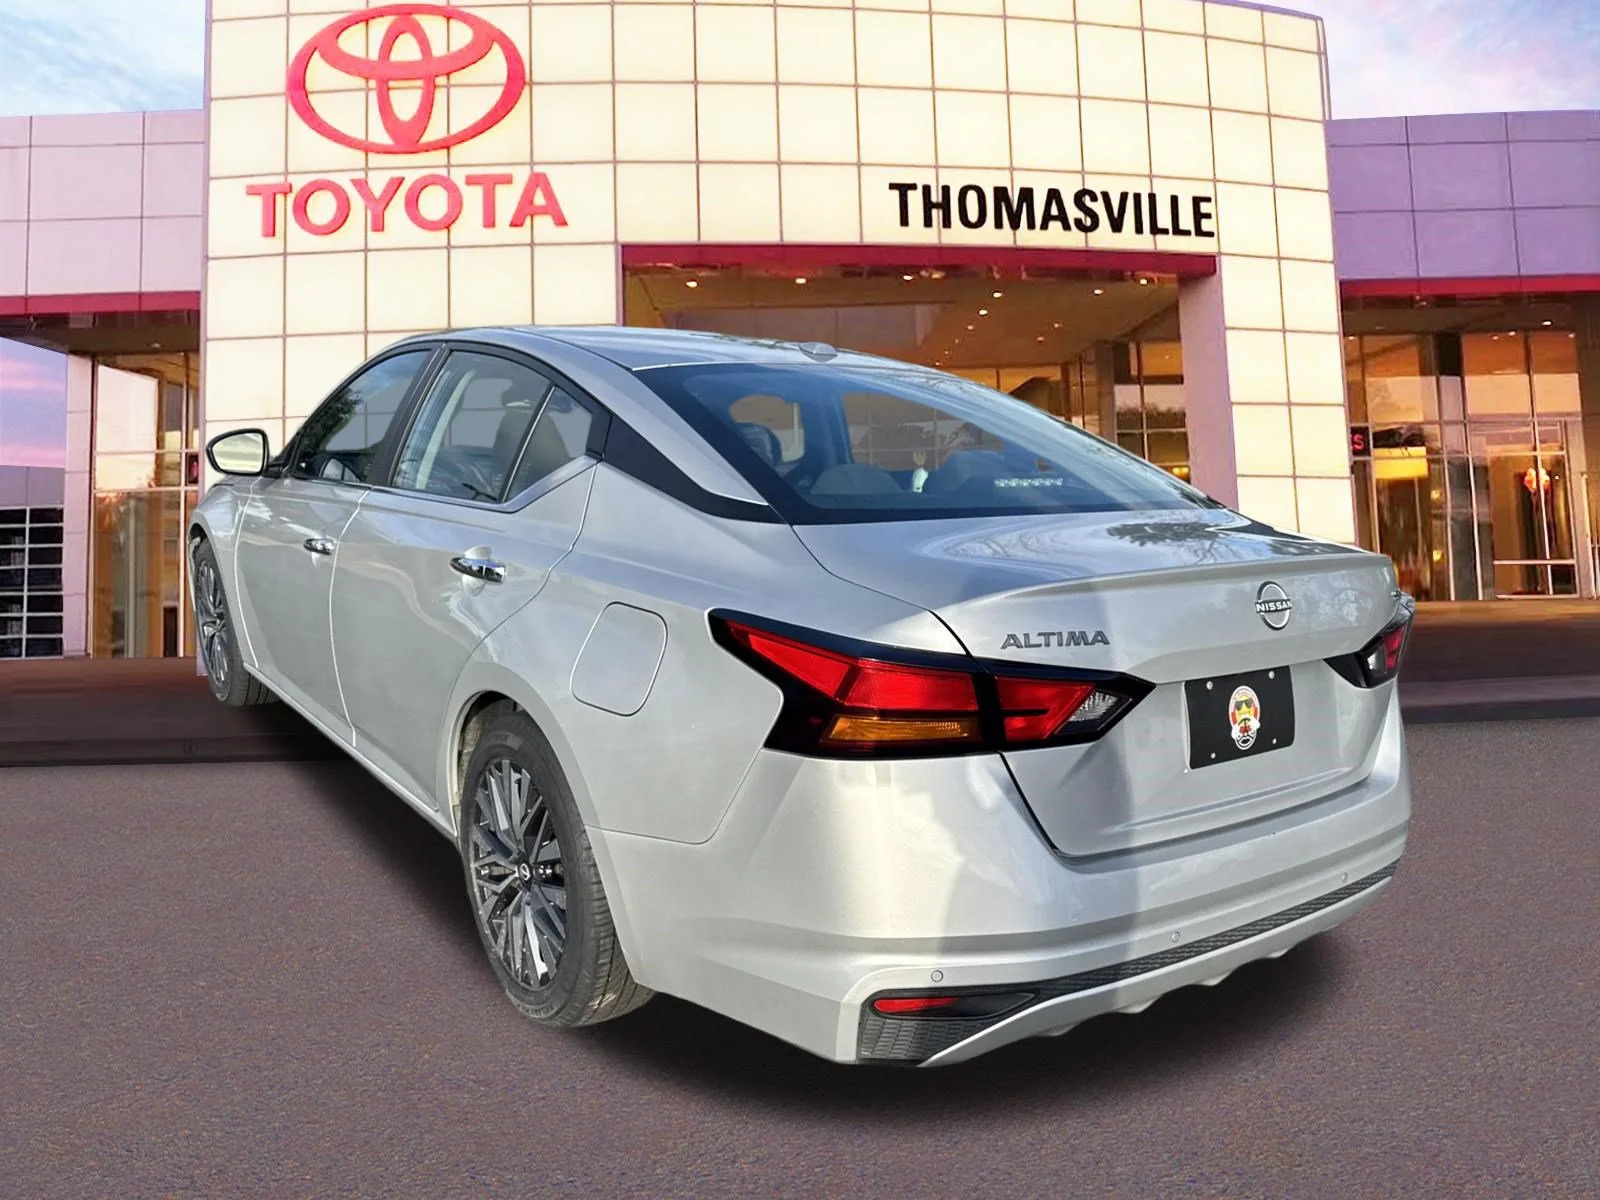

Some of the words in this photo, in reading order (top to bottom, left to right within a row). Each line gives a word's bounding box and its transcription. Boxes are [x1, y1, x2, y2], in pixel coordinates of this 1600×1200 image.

[246, 171, 569, 238] TOYOTA
[888, 182, 1217, 238] THOMASVILLE
[1255, 600, 1293, 613] NISSAN
[1000, 630, 1110, 650] ALTIMA
